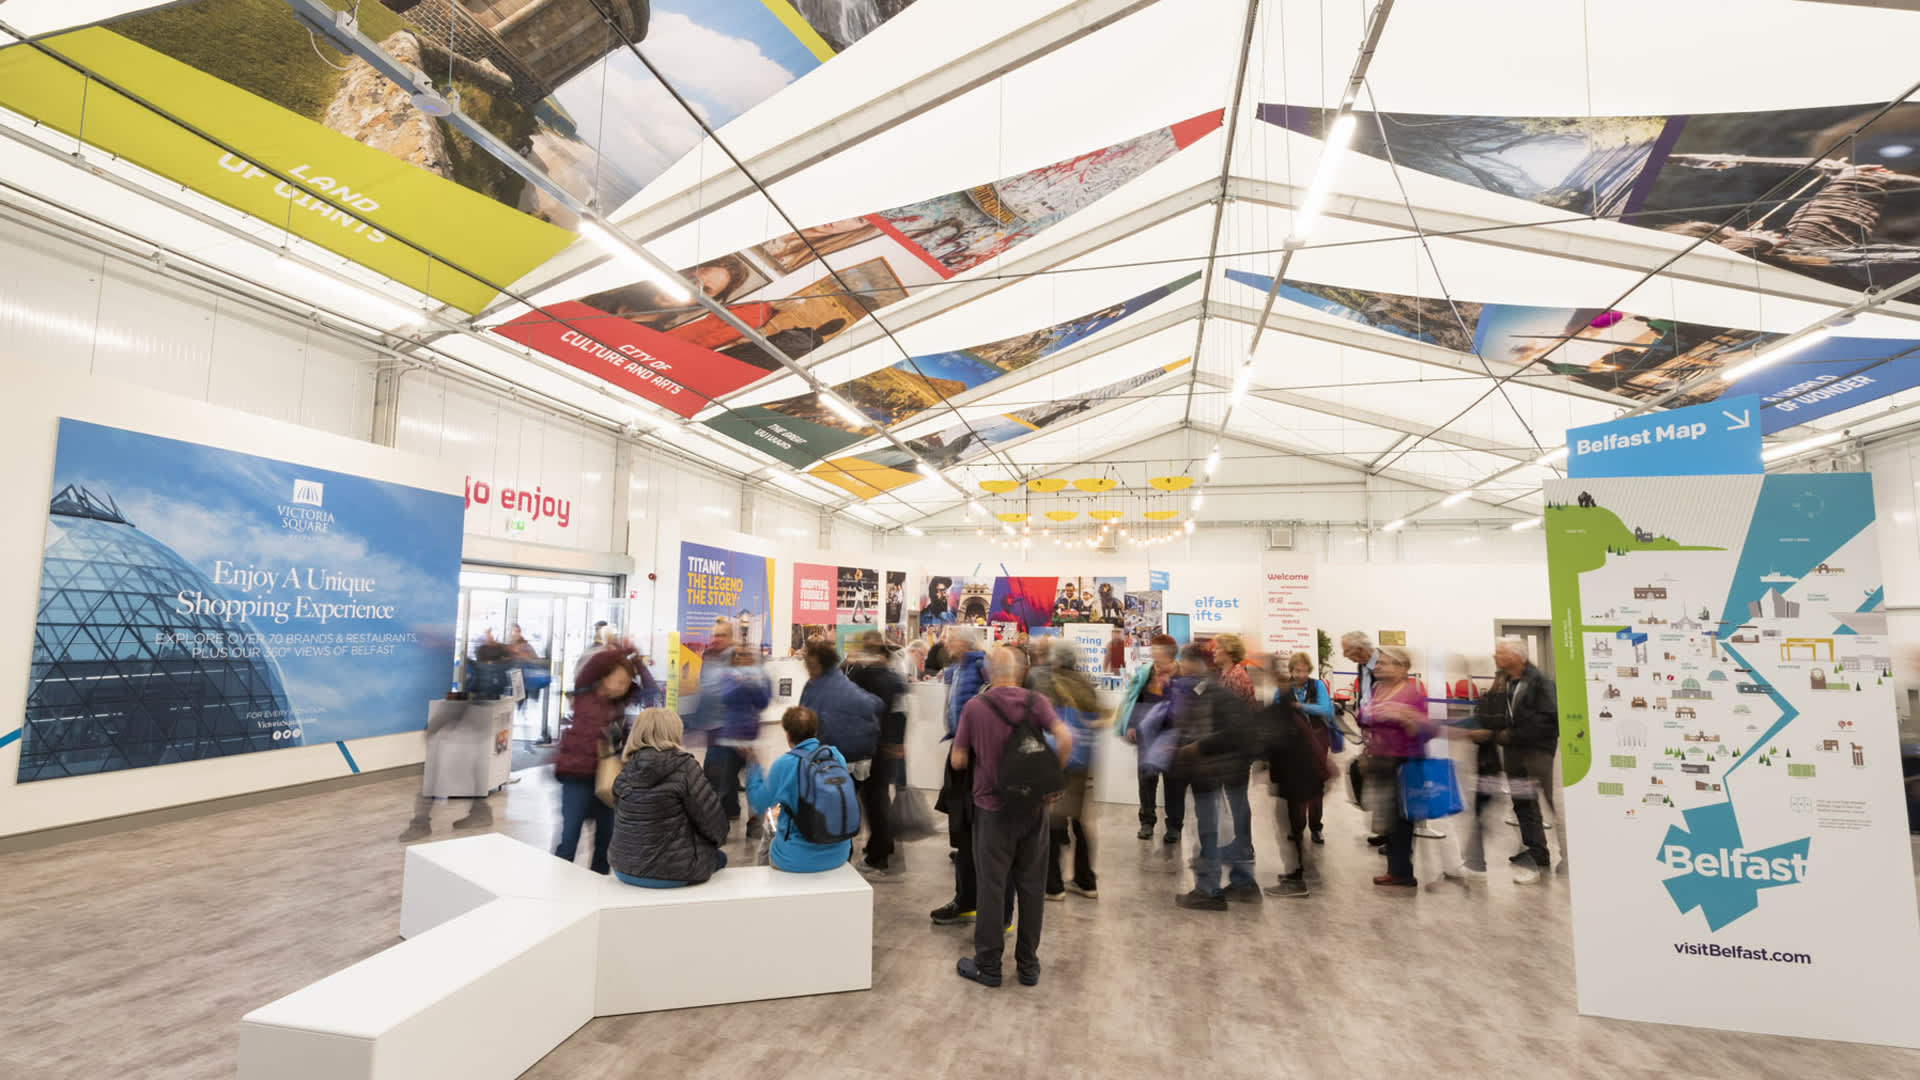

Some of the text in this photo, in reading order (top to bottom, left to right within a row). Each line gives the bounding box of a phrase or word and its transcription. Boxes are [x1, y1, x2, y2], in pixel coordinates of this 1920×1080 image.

[217, 152, 386, 243] OF GIANTS
[288, 164, 379, 212] LAND
[560, 330, 684, 395] CULTURE AND ARTS
[618, 344, 673, 371] CITY OF
[1775, 375, 1877, 412] OF WONDER
[1577, 422, 1707, 456] Belfast Map
[465, 475, 571, 528] o enjoy
[277, 504, 336, 524] VICTORIA
[281, 517, 329, 533] SQUARE
[688, 555, 726, 576] TITANIC
[213, 560, 376, 598] Enjoy A Unique
[687, 572, 744, 593] THE LEGEND
[175, 589, 395, 625] Shopping Experience
[686, 588, 738, 608] THE STORY
[1195, 596, 1240, 609] elfast
[1196, 609, 1223, 622] ifts
[155, 632, 225, 645] EXPLORE
[228, 632, 264, 645] OVER
[267, 633, 284, 645] 70
[286, 633, 334, 645] BRANDS
[335, 633, 344, 644] &
[192, 647, 228, 658] PLUS
[231, 647, 261, 658] OUR
[294, 645, 332, 657] VIEWS
[332, 645, 350, 656] OF
[351, 644, 396, 656] BELFAST
[1664, 845, 1808, 883] Belfast
[1674, 942, 1812, 964] visitBelfast.com
